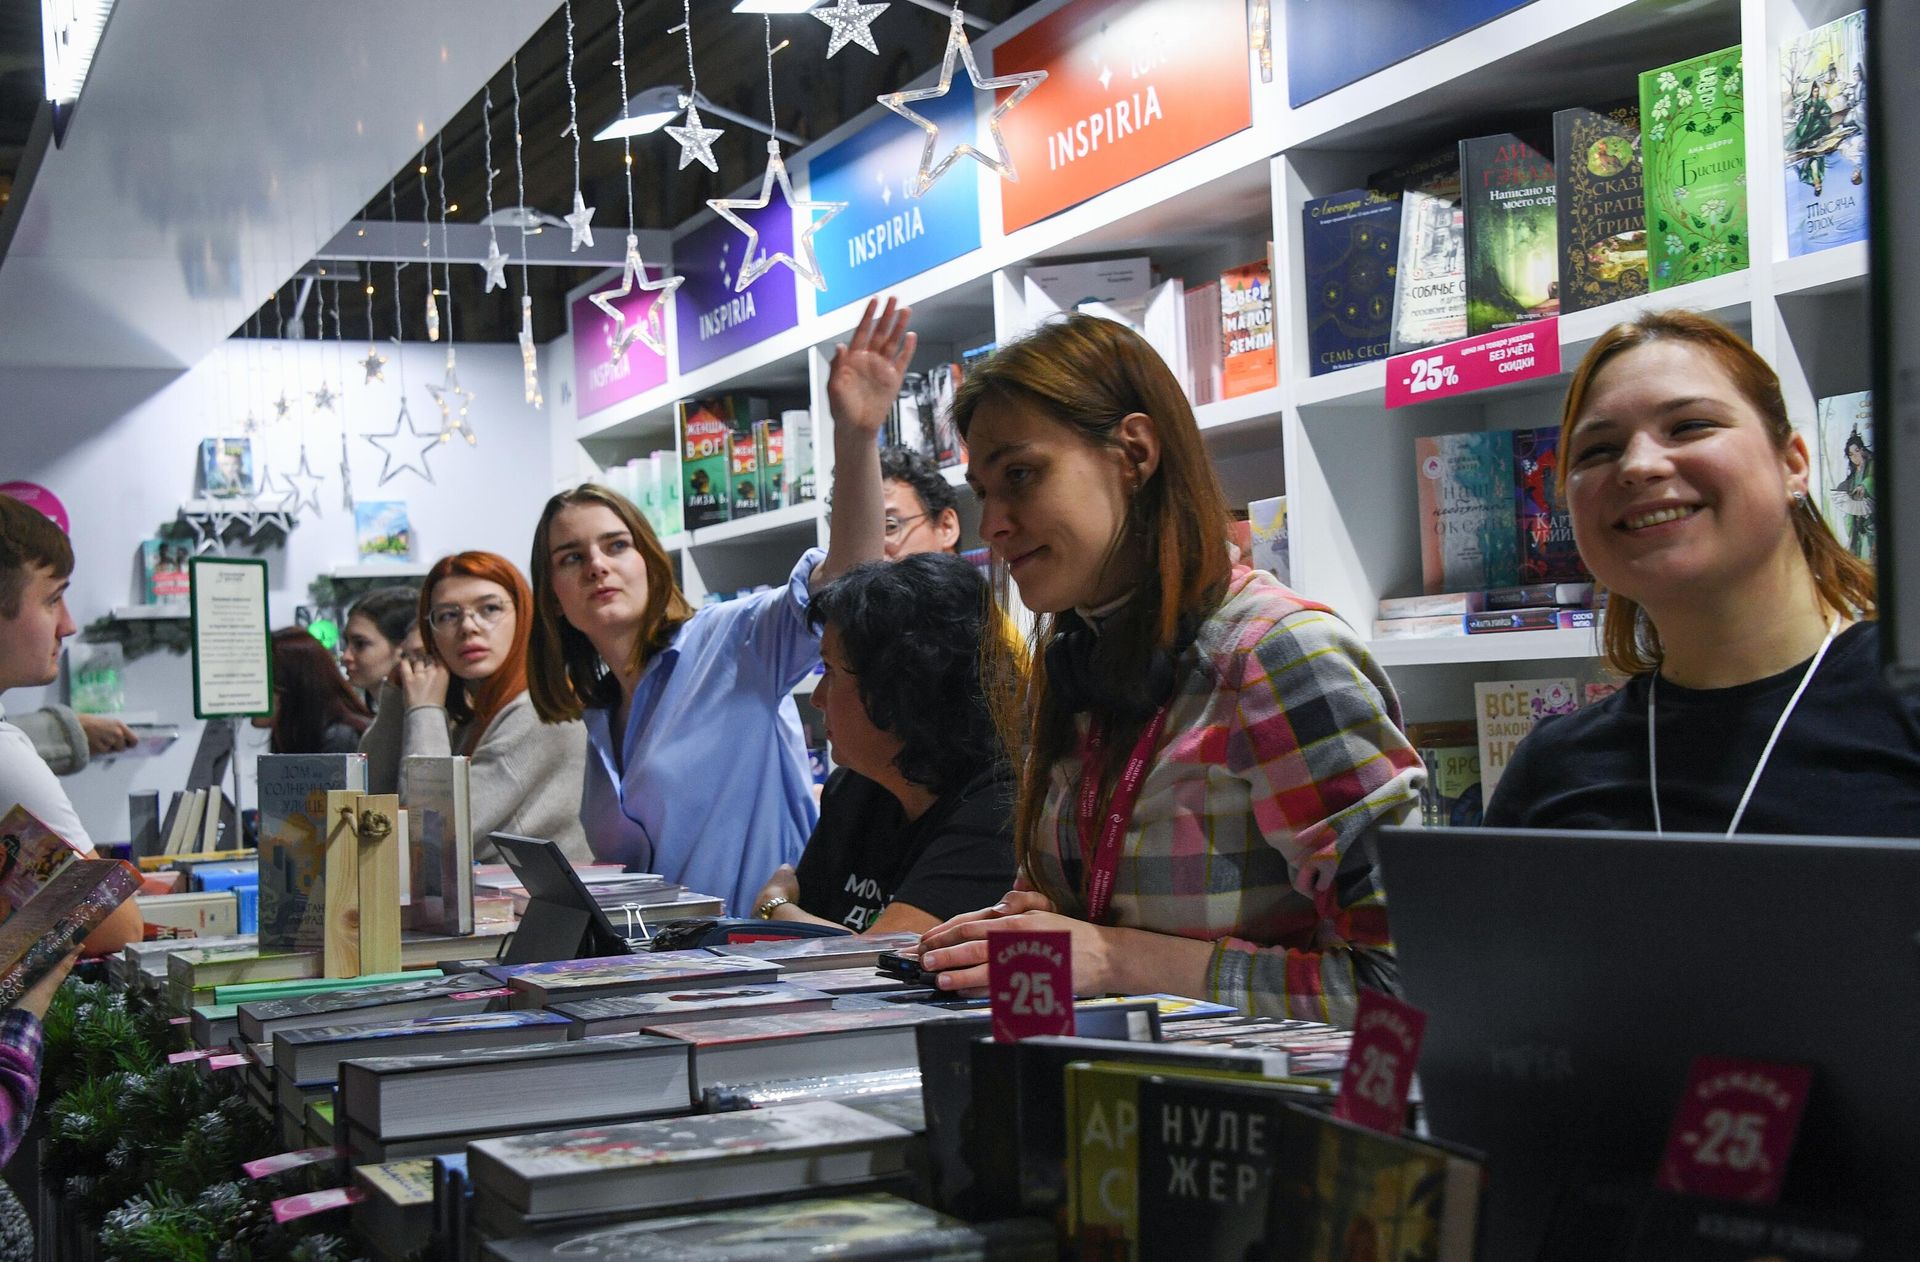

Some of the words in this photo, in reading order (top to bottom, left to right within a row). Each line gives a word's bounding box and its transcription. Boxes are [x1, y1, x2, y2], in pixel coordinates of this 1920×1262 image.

[1047, 85, 1163, 171] INSPIRIA
[1489, 186, 1543, 201] Написано
[1502, 198, 1534, 210] моего
[1535, 195, 1557, 207] сер
[848, 206, 925, 268] INSPIRIA
[1412, 282, 1455, 299] СОБАЧЬЕ
[699, 291, 756, 342] INSPIRIA
[1229, 332, 1273, 355] ЗЕМЛИ
[1489, 348, 1506, 363] БЕЗ
[1507, 341, 1535, 358] УЧЁТА
[1320, 348, 1354, 365] СЕМЬ
[1498, 356, 1535, 374] СКИДКИ
[1402, 355, 1459, 394] -25%
[686, 440, 696, 459] В
[689, 493, 716, 507] ЛИЗА
[1487, 720, 1533, 737] ЗАКОН
[997, 940, 1065, 967] СКИДКА
[1162, 1103, 1267, 1157] НУЛЕ
[1168, 1154, 1266, 1207] ЖЕР
